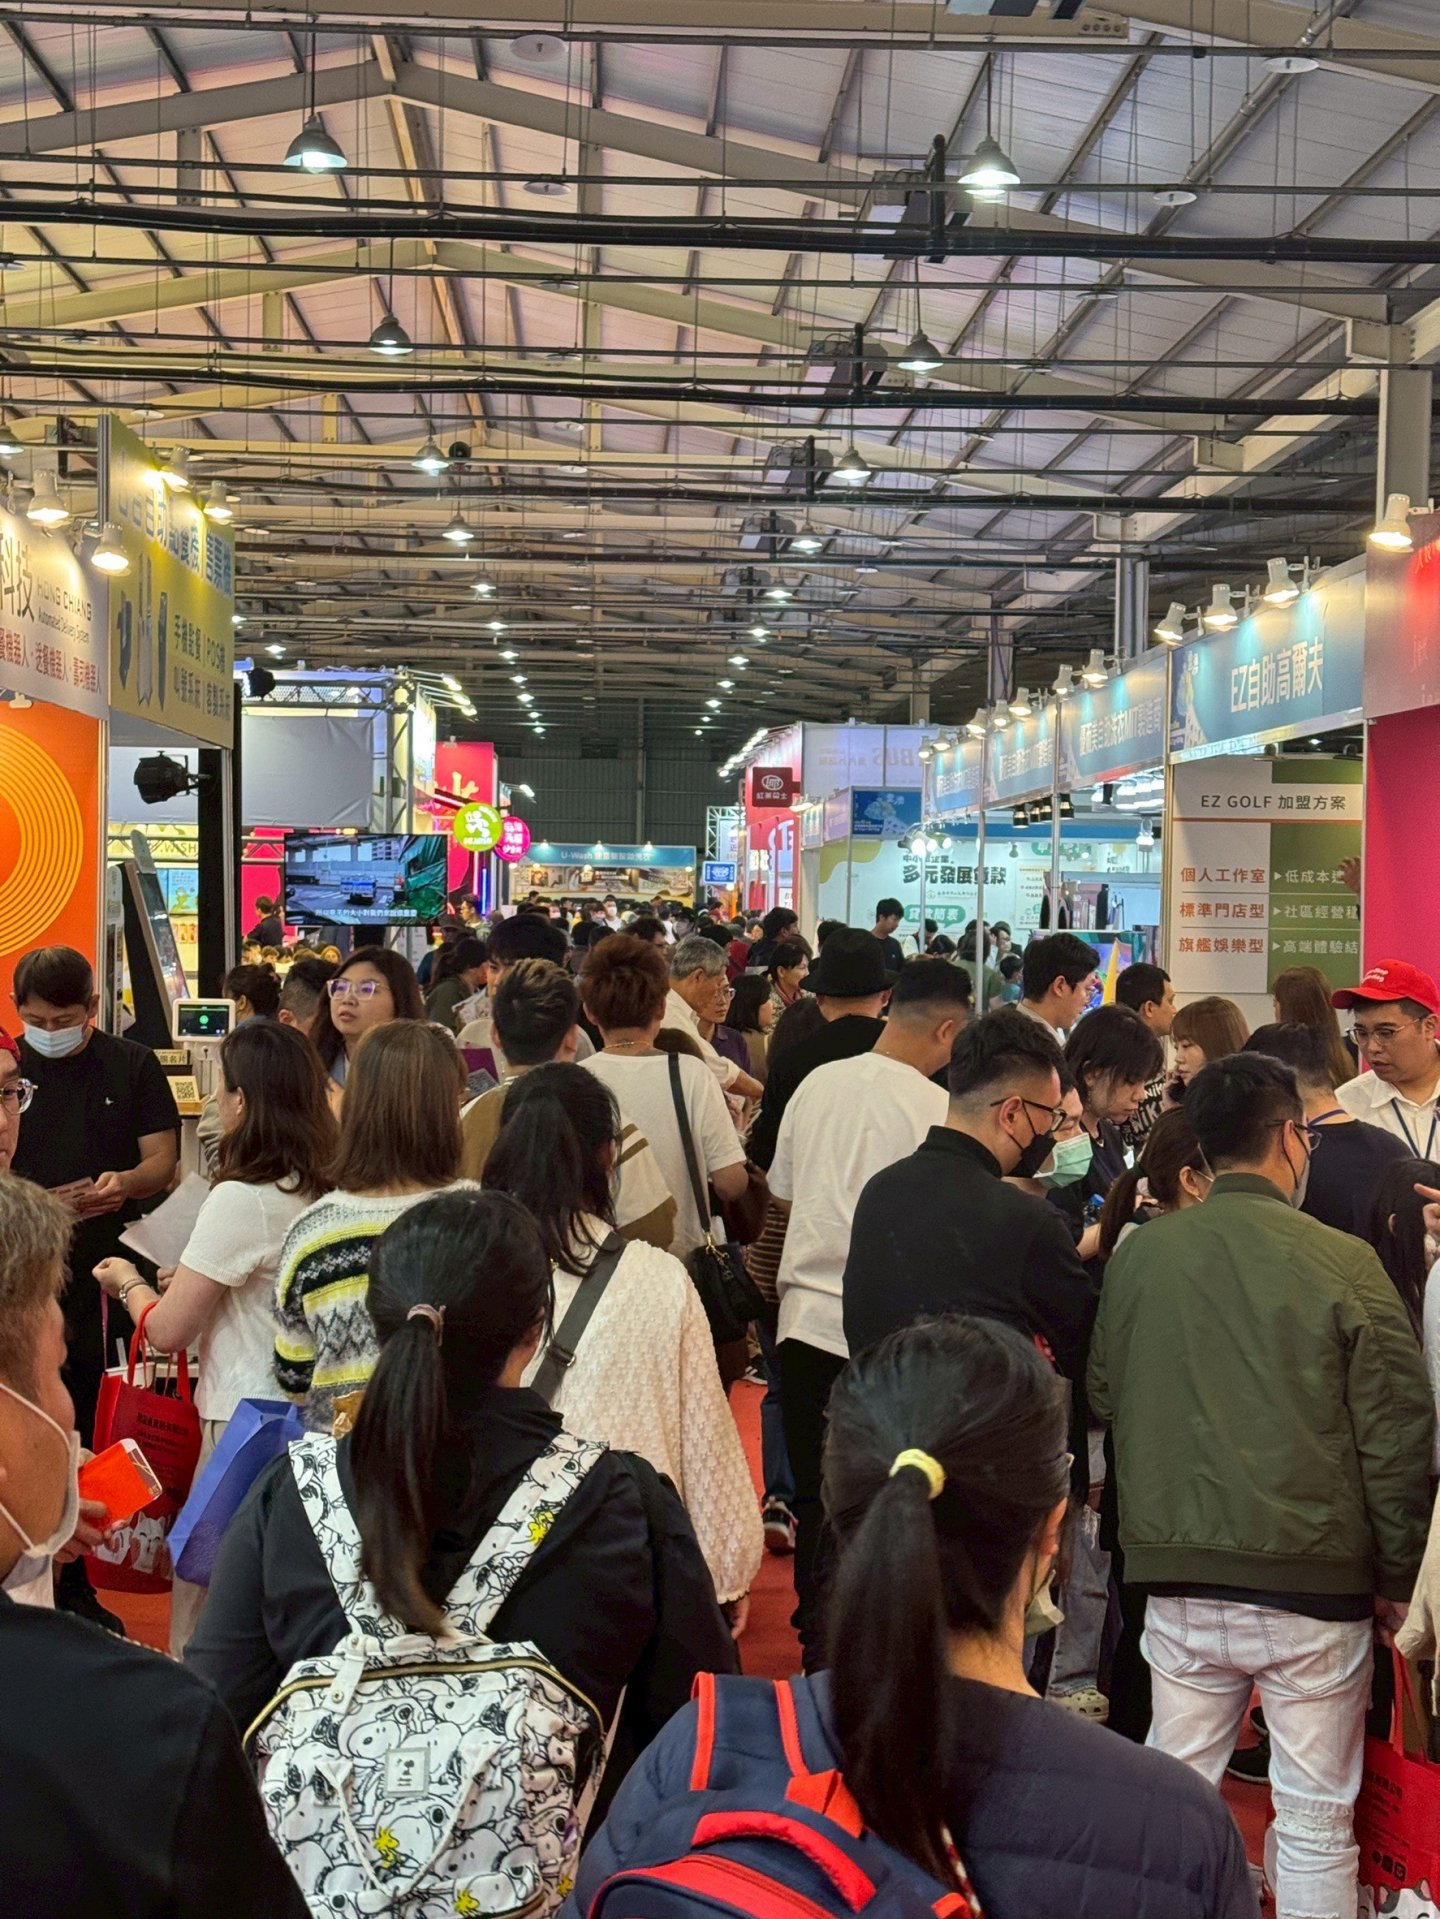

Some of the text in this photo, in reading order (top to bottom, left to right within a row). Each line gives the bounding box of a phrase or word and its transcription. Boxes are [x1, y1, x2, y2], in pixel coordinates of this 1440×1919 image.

[37, 578, 92, 622] HONG CHIANG
[1231, 636, 1323, 713] EZ自助高爾夫
[1201, 795, 1347, 811] EZ GOLF 加盟方案
[1180, 867, 1266, 884] 個人工作室
[1179, 902, 1265, 919] 標準門店型
[1178, 937, 1264, 954] 旗艦娛樂型
